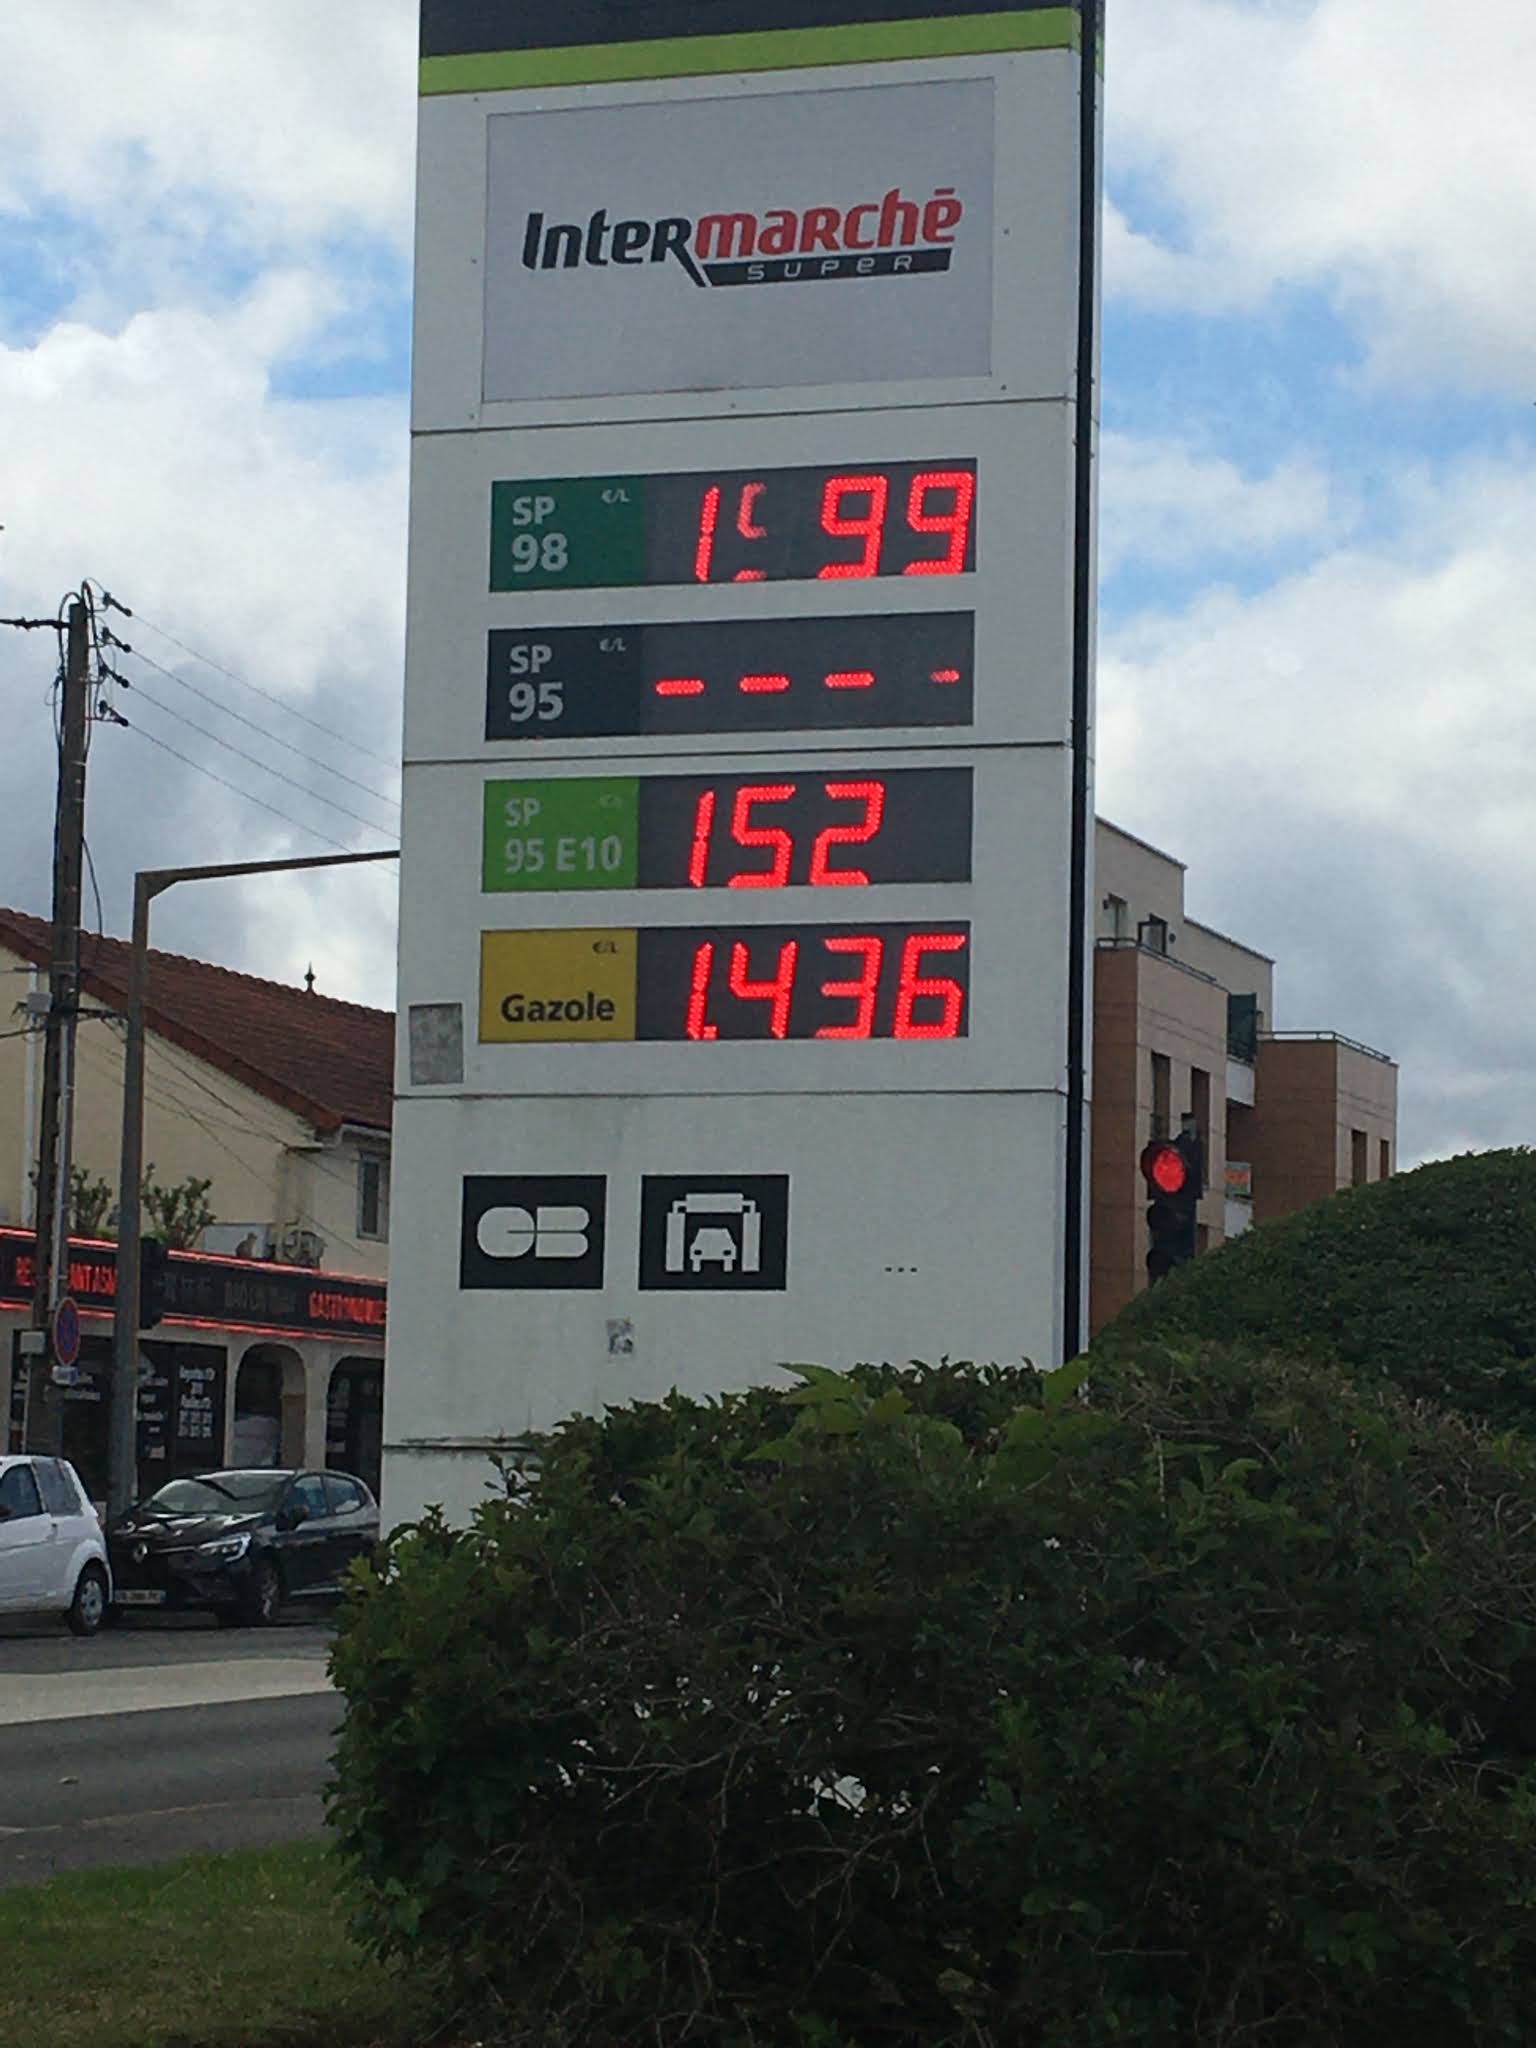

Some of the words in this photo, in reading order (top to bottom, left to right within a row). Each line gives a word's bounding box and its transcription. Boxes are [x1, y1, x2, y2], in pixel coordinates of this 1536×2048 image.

[512, 496, 556, 527] SP
[511, 533, 569, 573] 98
[509, 645, 553, 674] SP
[508, 682, 564, 722] 95
[504, 798, 541, 828] SP
[688, 780, 885, 888] 152
[504, 837, 545, 873] 95
[555, 836, 622, 873] E10
[501, 992, 616, 1025] Gazole
